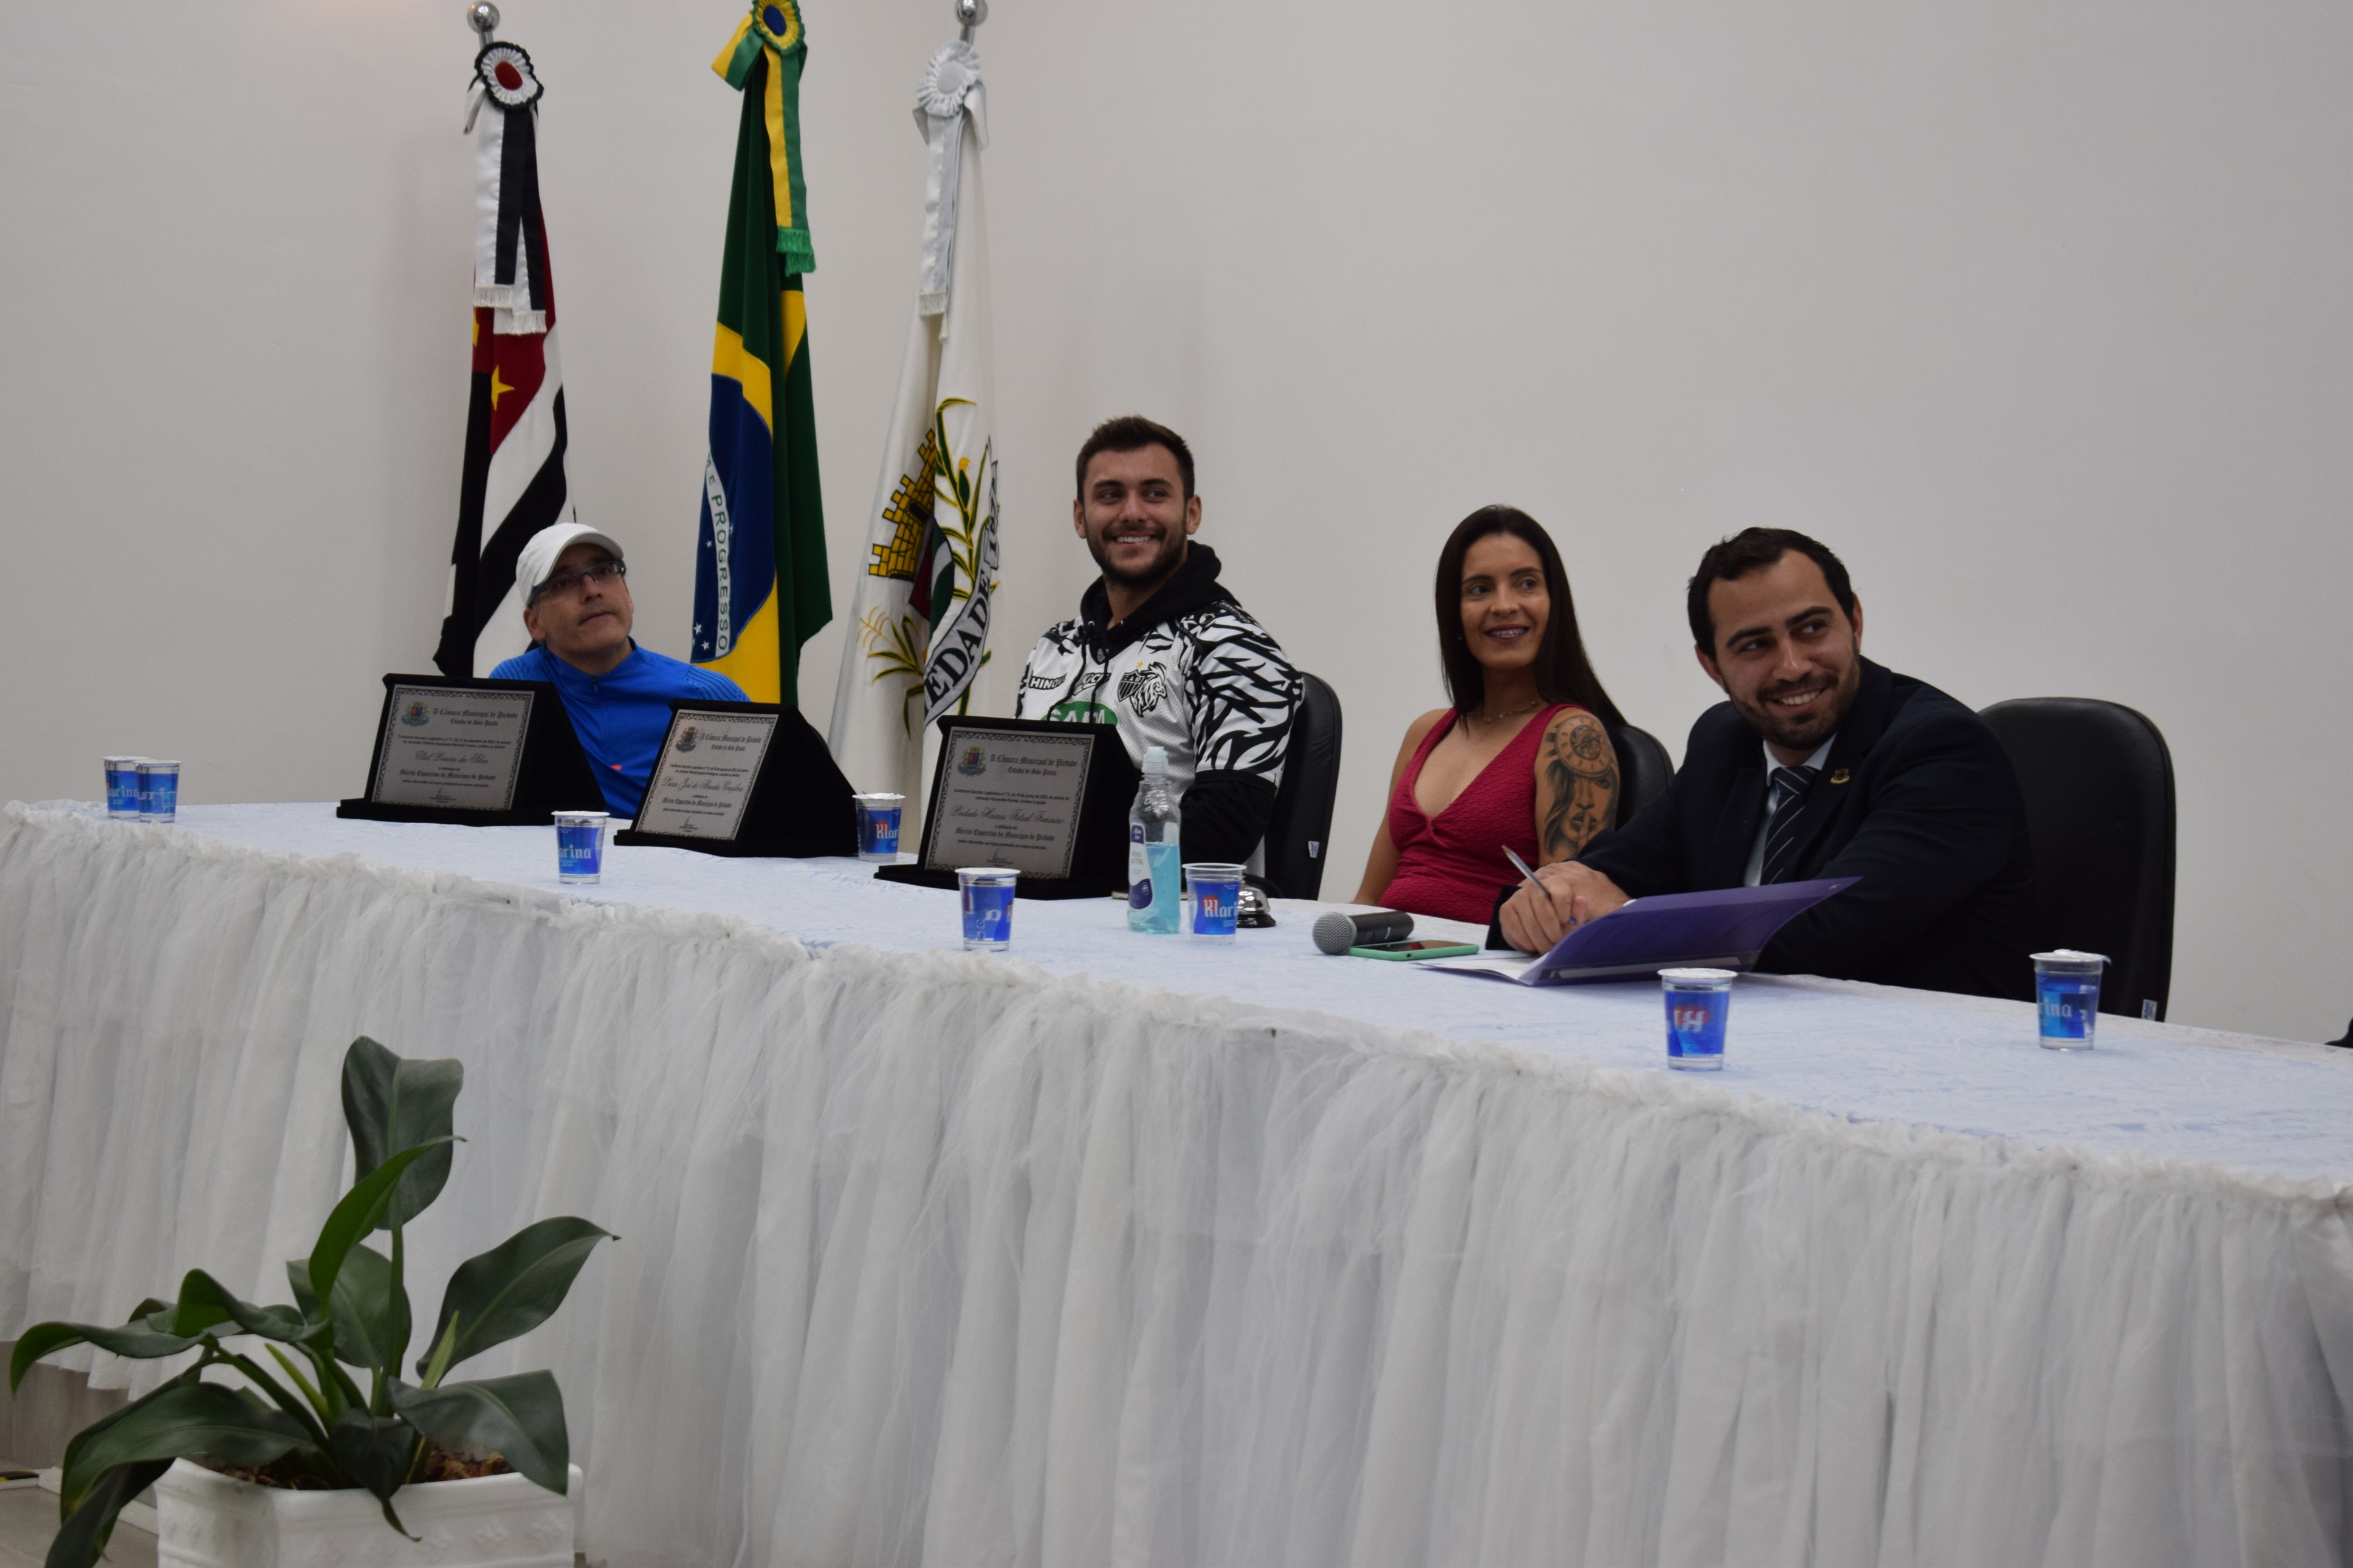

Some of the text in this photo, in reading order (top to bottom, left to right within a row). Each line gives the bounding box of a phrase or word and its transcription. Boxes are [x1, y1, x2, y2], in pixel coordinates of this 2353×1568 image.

[710, 495, 729, 650] PROGRESSO
[997, 754, 1018, 763] Câmara
[1020, 756, 1048, 766] Municipal
[1056, 759, 1077, 769] Piedade
[1042, 768, 1057, 776] Paulo
